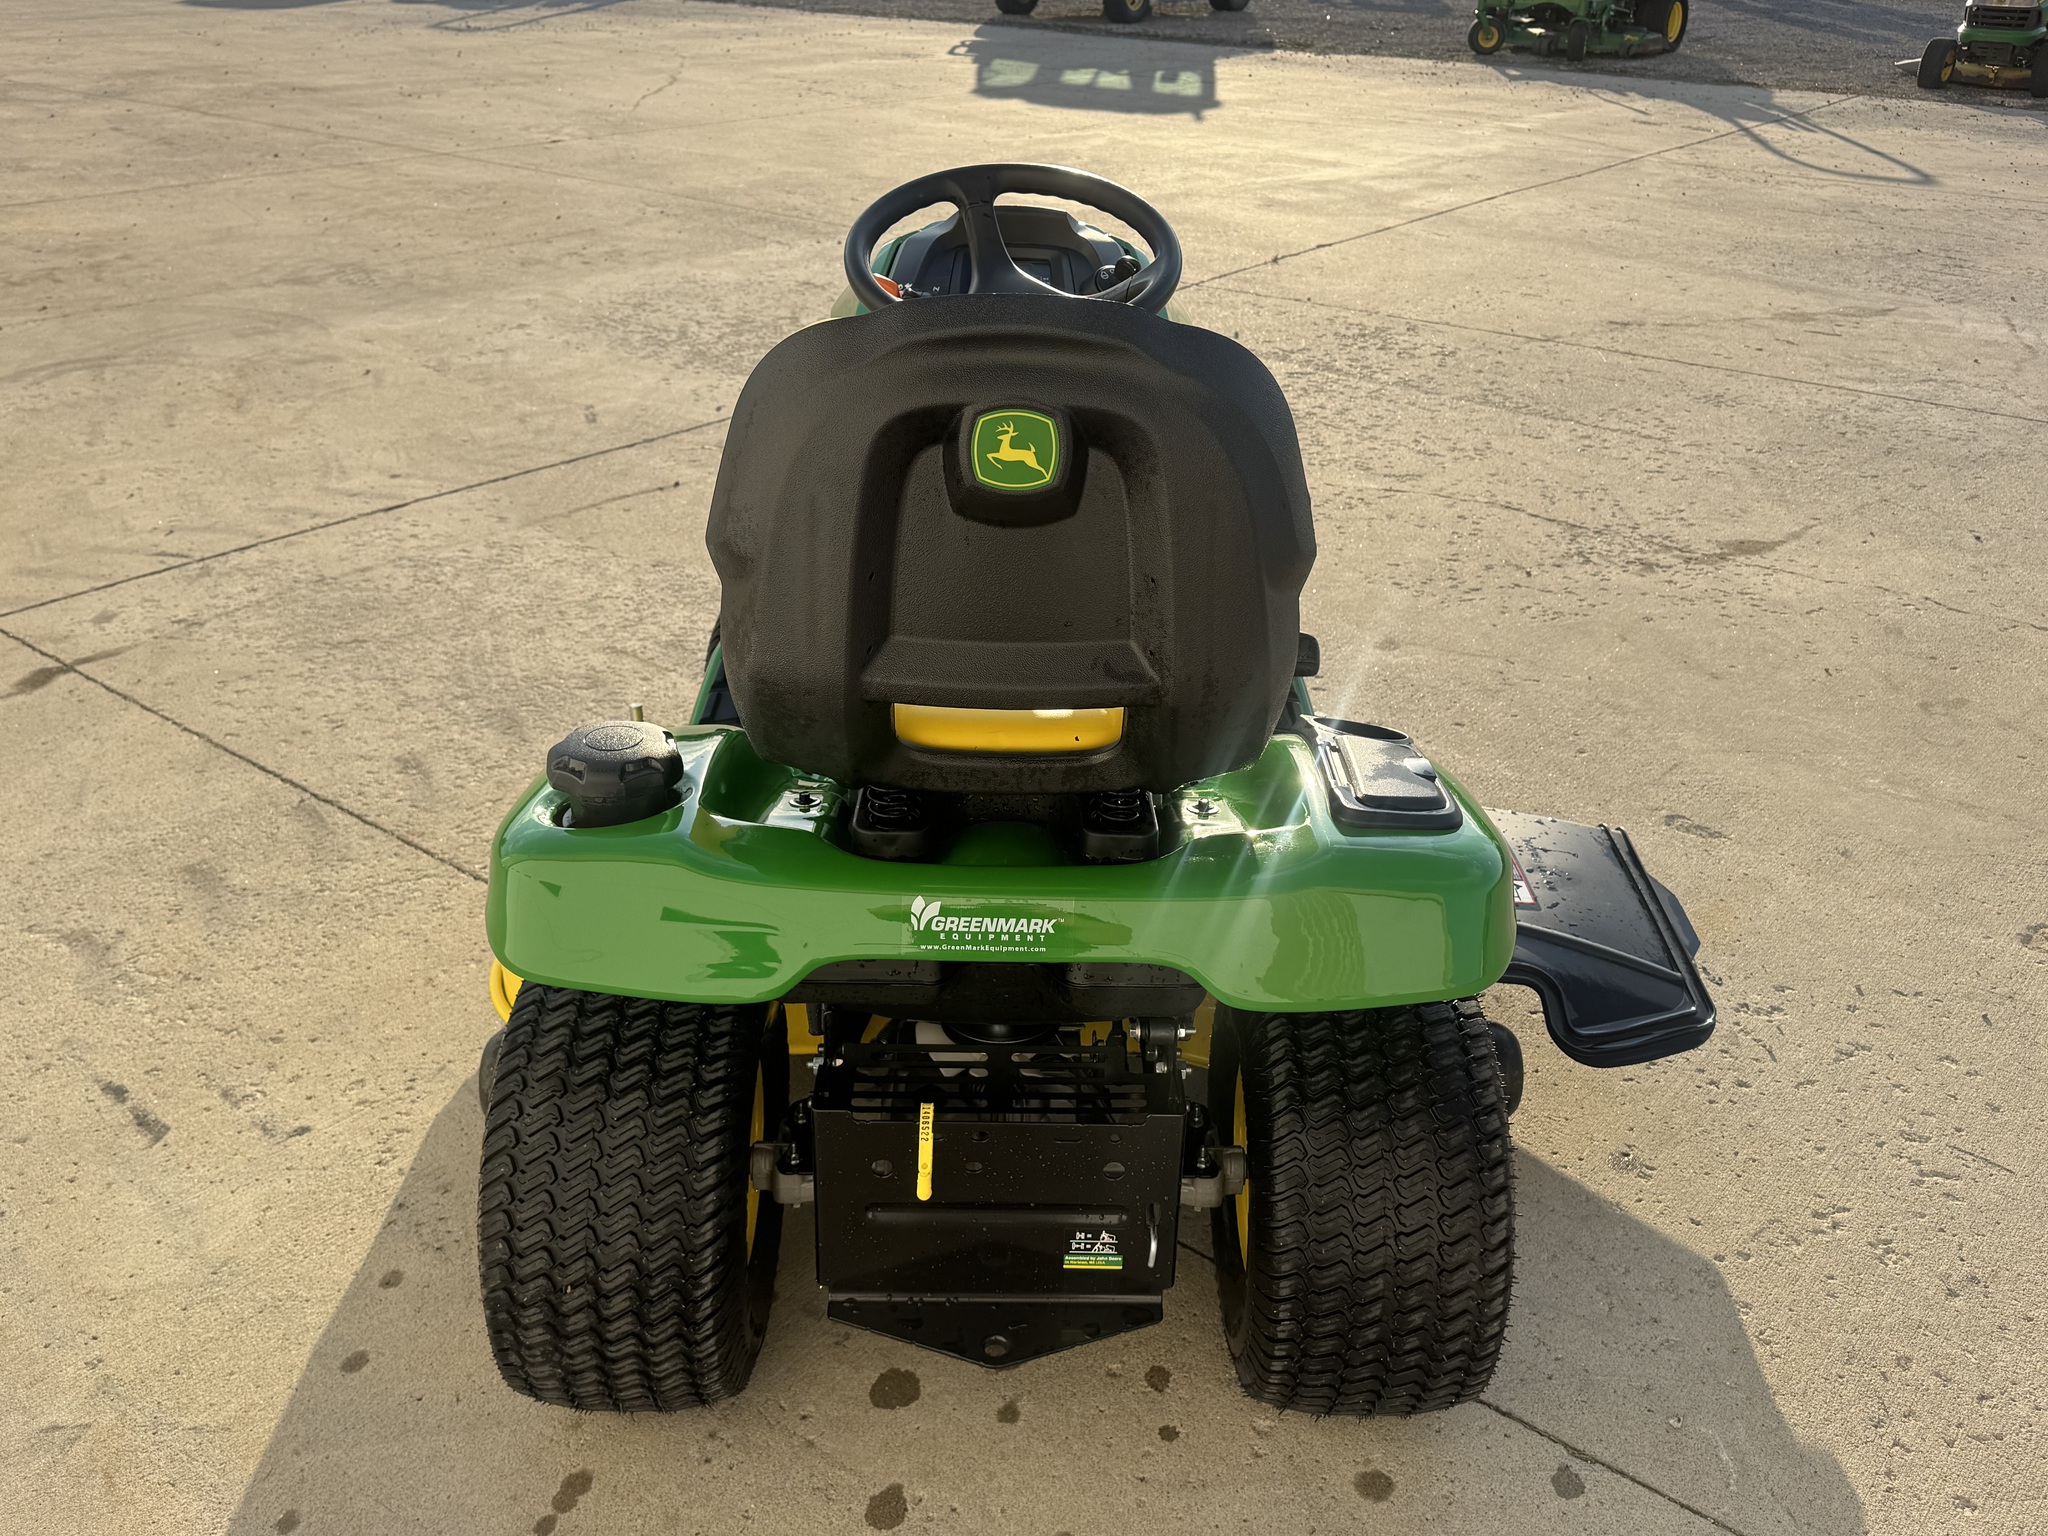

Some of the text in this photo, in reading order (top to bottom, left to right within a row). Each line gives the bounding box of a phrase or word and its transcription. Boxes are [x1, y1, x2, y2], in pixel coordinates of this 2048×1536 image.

[931, 916, 1057, 933] GREENMARK
[939, 932, 1045, 942] EQUIPMENT
[920, 943, 1047, 953] www.GreenMarkEquipment.com
